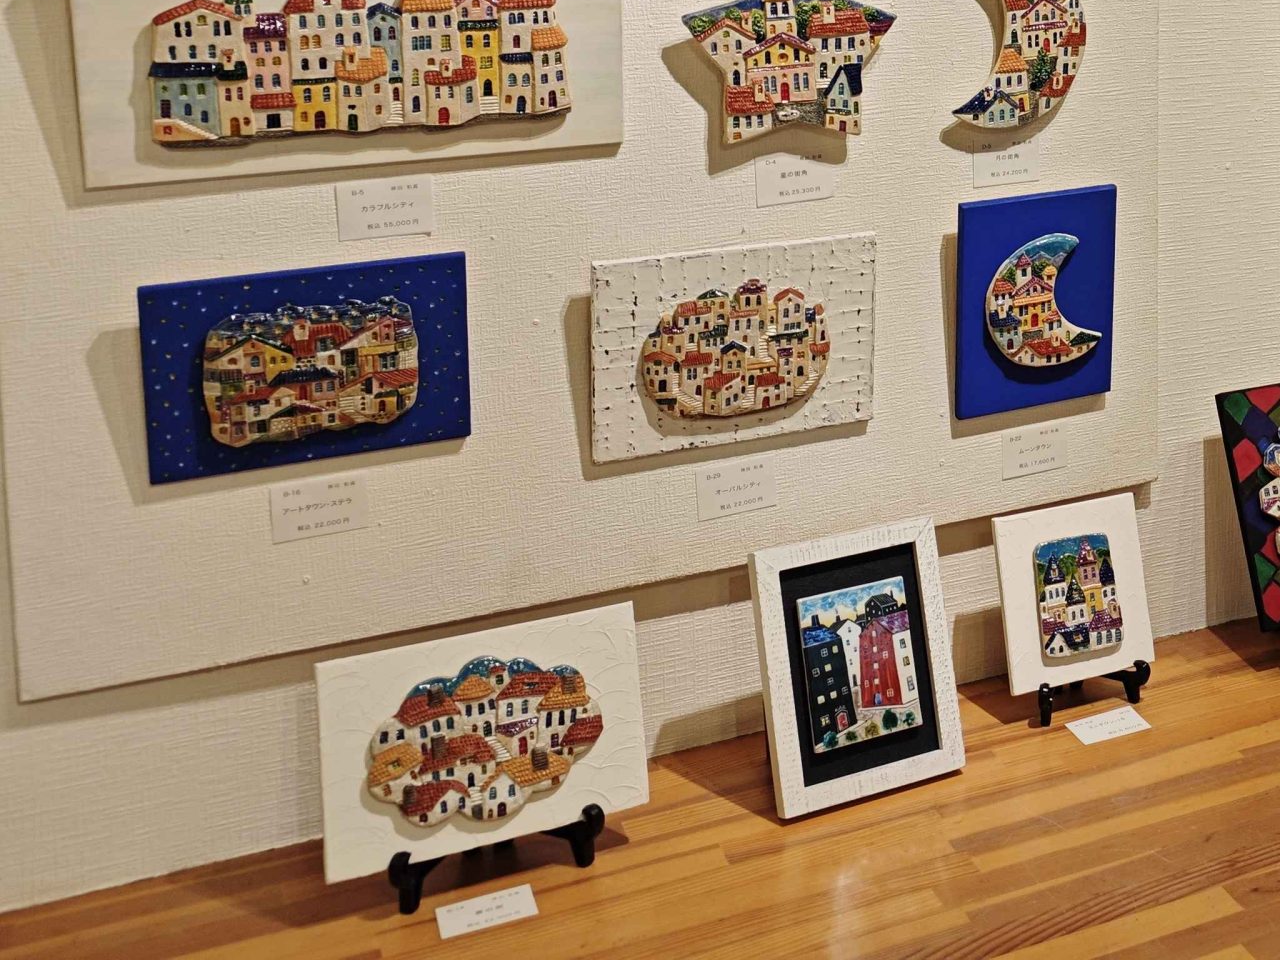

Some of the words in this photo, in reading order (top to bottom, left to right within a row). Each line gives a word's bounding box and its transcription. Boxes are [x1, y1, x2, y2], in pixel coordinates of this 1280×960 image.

[361, 201, 415, 213] カラフルシティ
[1019, 443, 1052, 455] ムーンタウン
